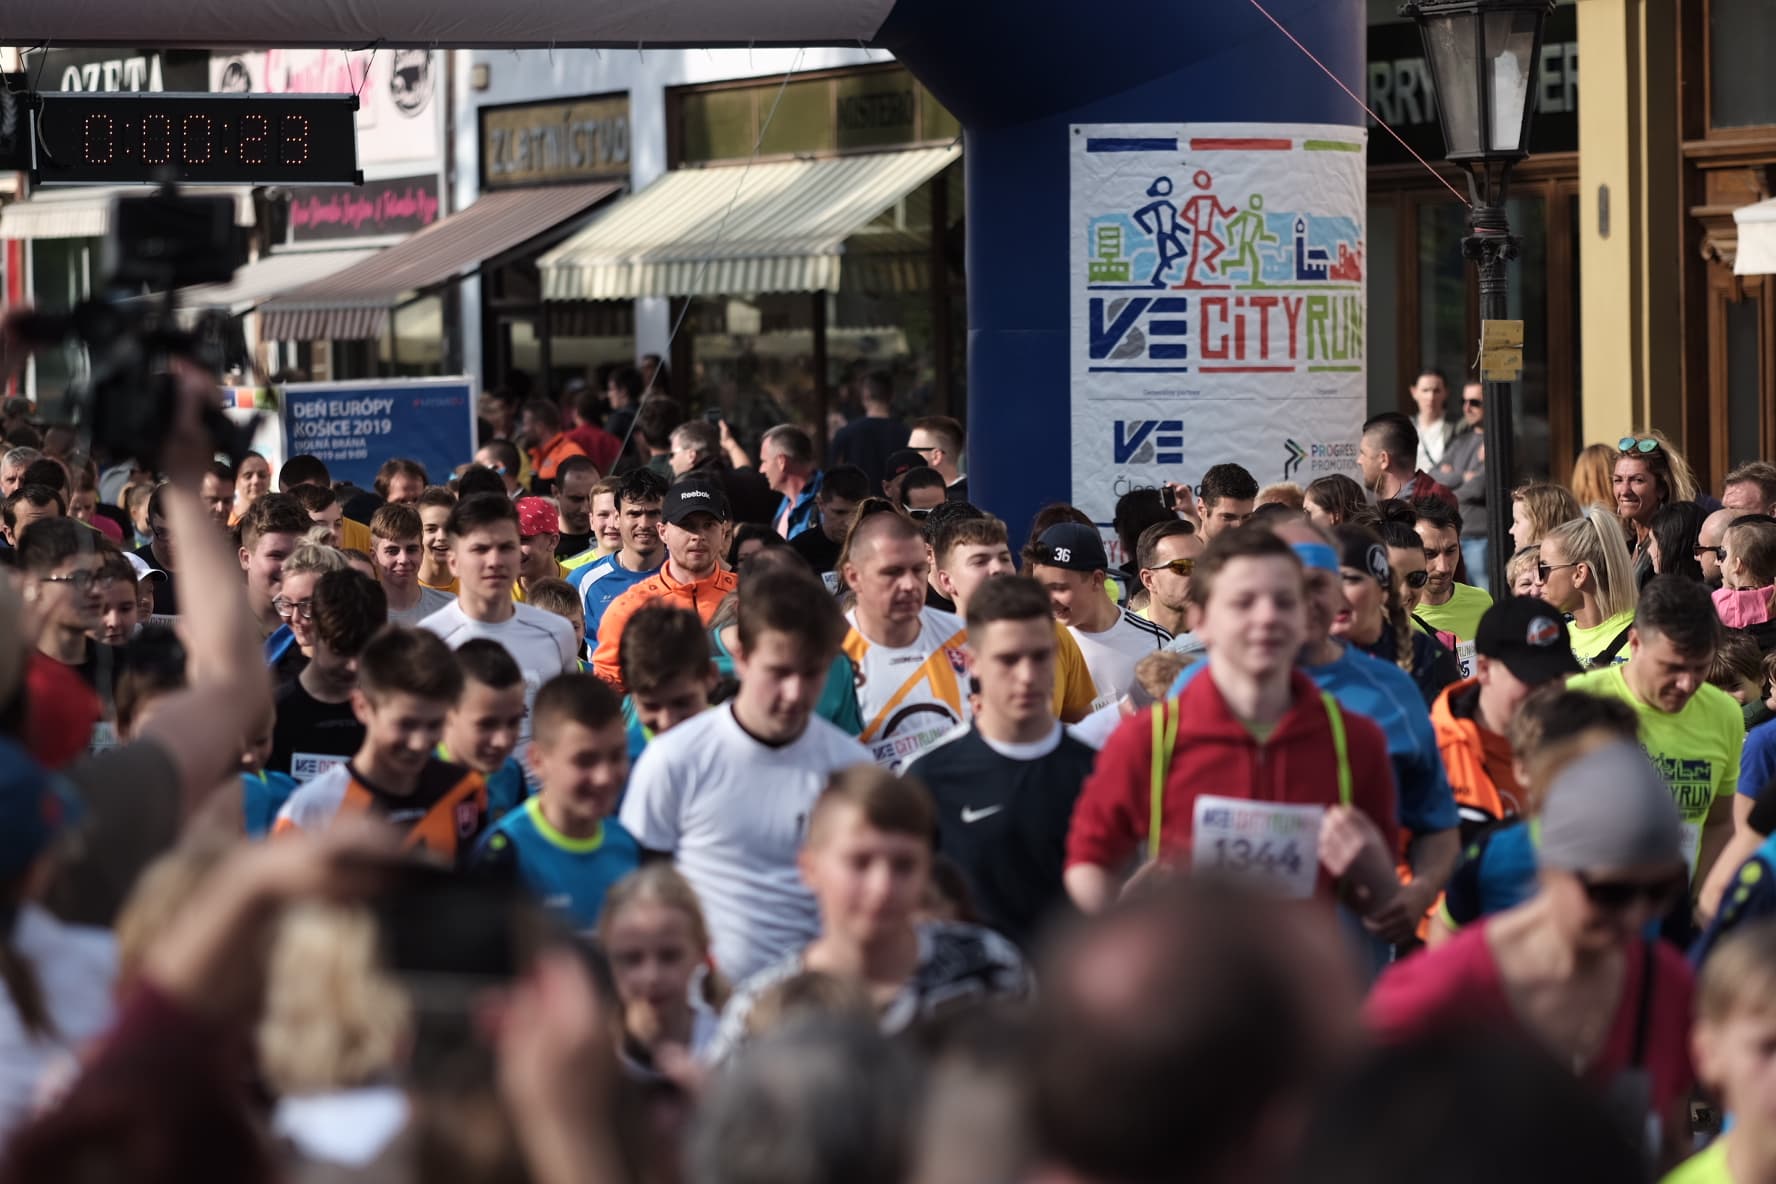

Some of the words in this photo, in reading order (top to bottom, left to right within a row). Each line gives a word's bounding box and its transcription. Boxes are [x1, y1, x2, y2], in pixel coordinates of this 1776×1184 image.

[1368, 57, 1434, 124] RRY
[84, 114, 309, 163] 0:00:23
[353, 419, 392, 434] 2019
[681, 490, 711, 500] Reebok
[1053, 546, 1071, 562] 36
[1215, 837, 1302, 876] 1344
